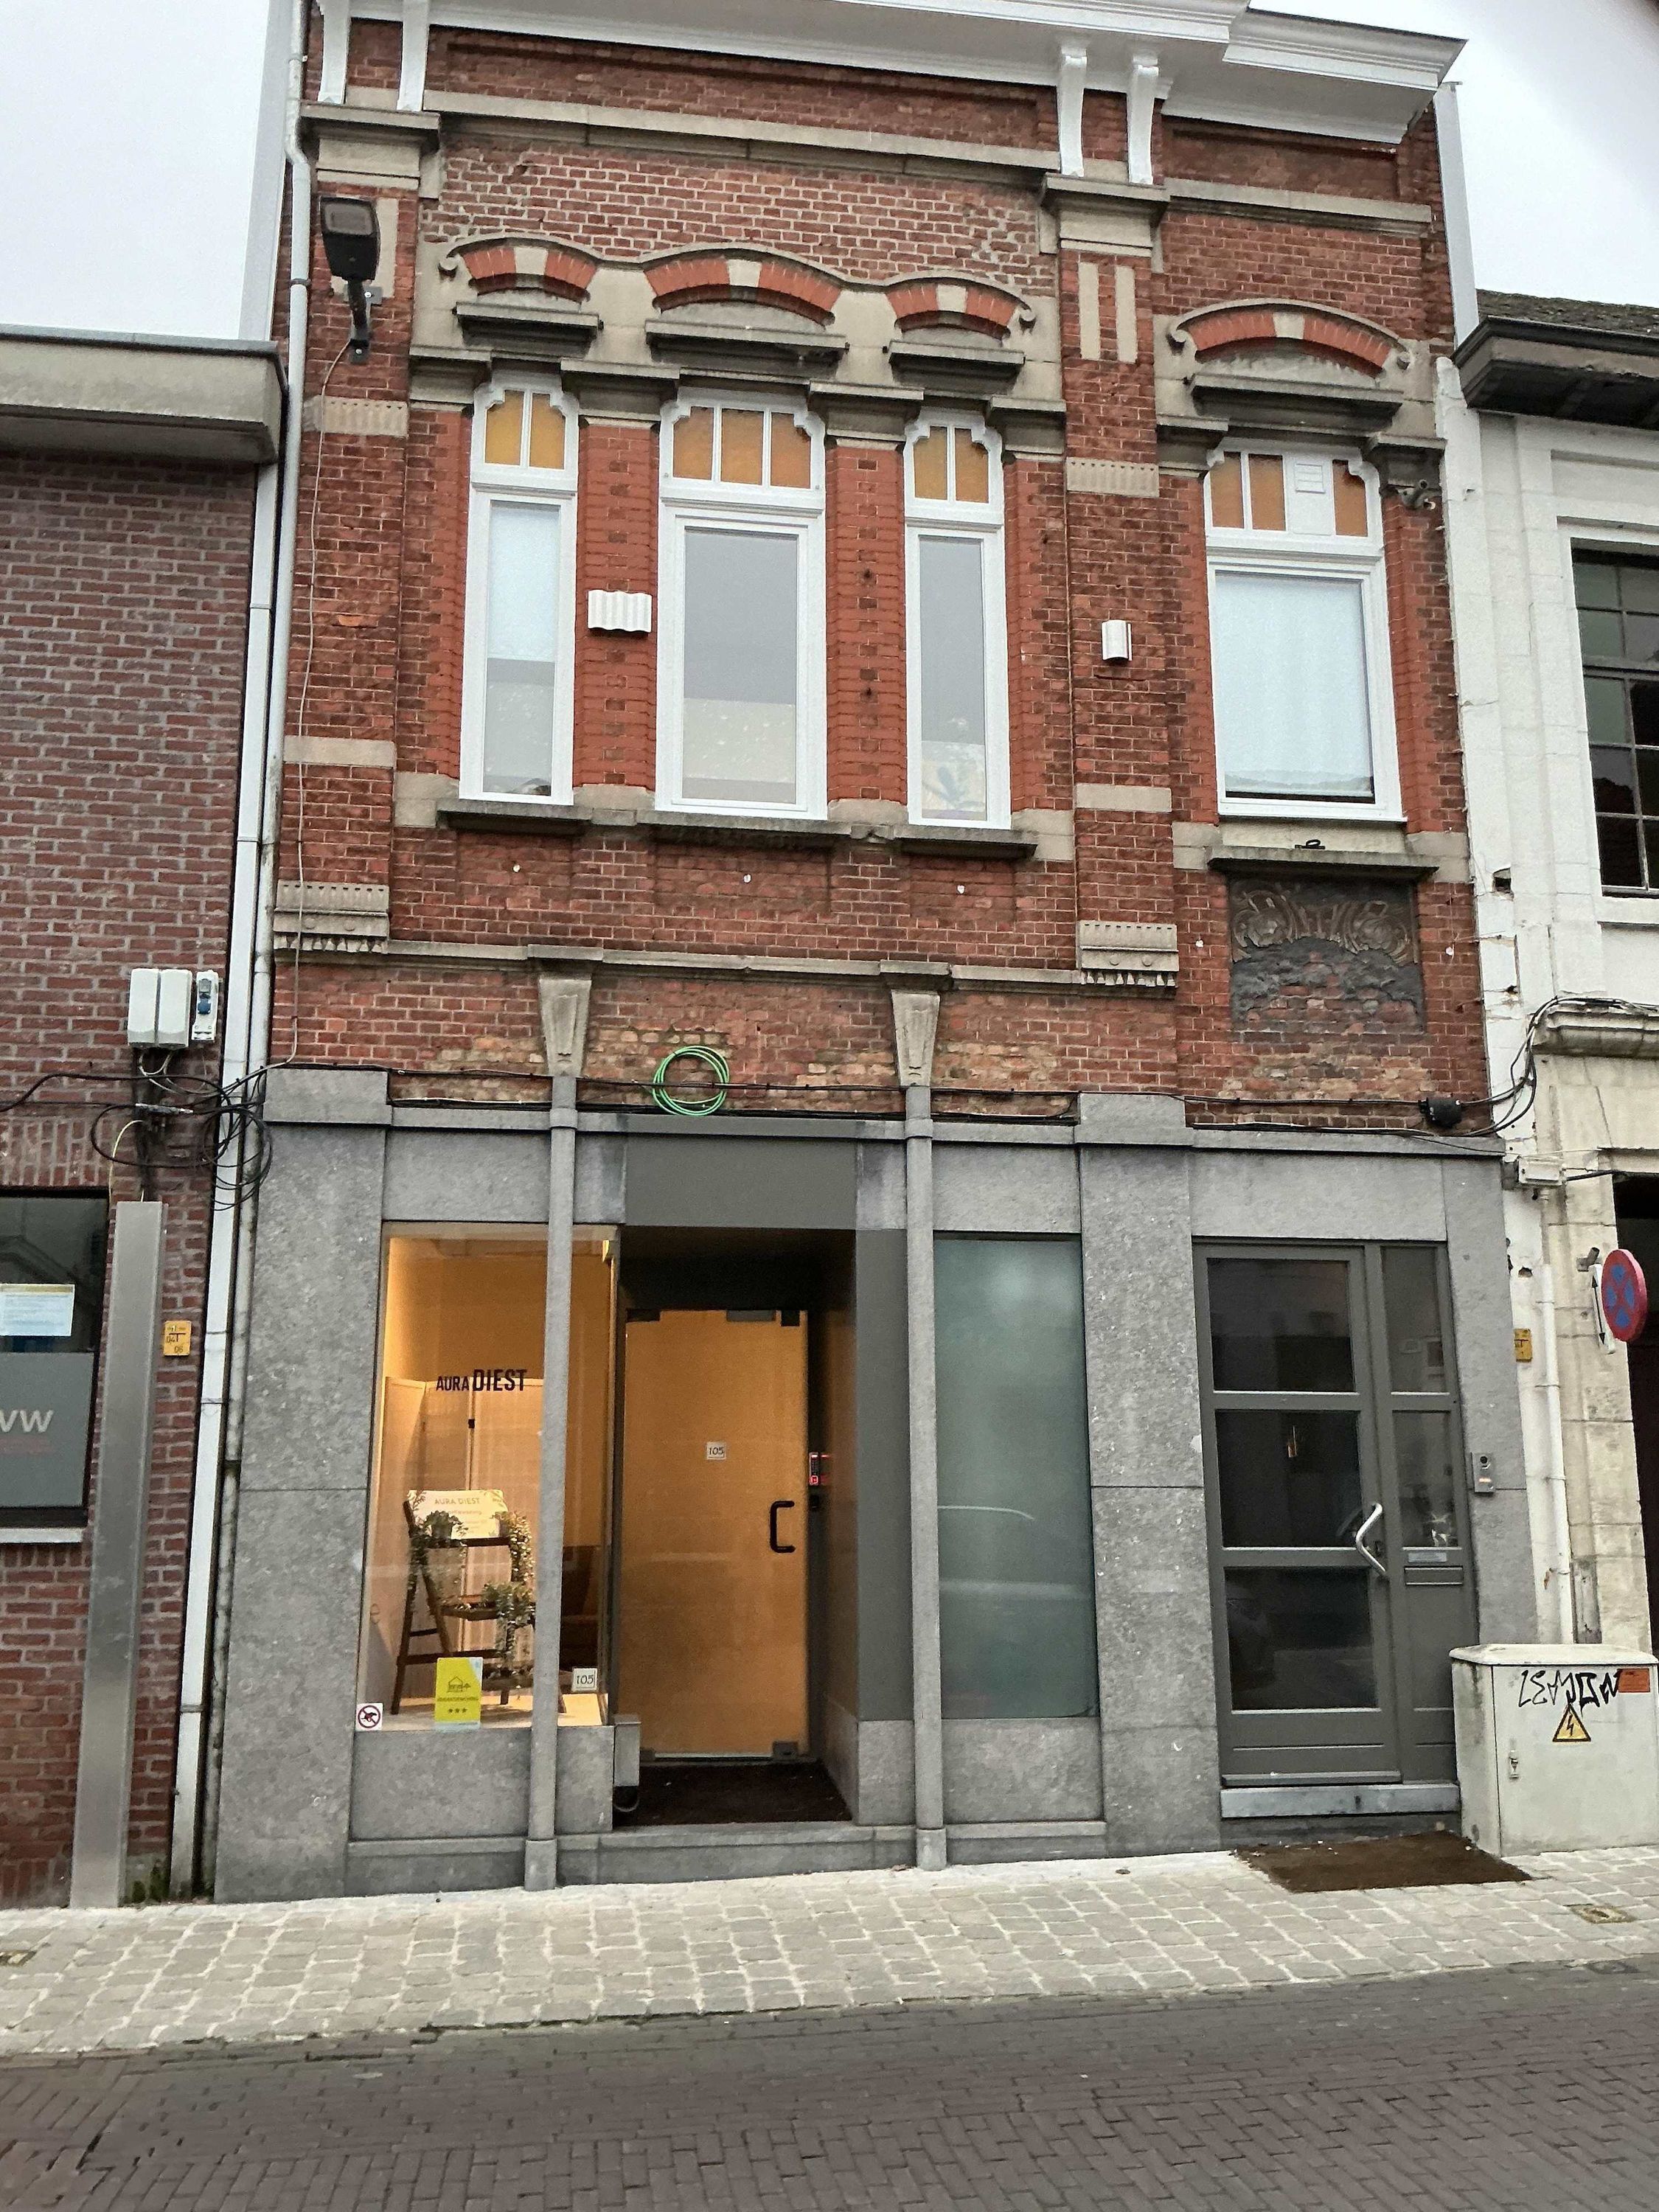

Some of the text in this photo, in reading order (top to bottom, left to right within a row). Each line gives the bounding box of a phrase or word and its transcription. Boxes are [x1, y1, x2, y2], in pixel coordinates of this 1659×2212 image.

[436, 1368, 528, 1391] AURA DIEST
[709, 1447, 725, 1455] 105
[458, 1497, 481, 1505] DIEST
[577, 1674, 594, 1685] 105
